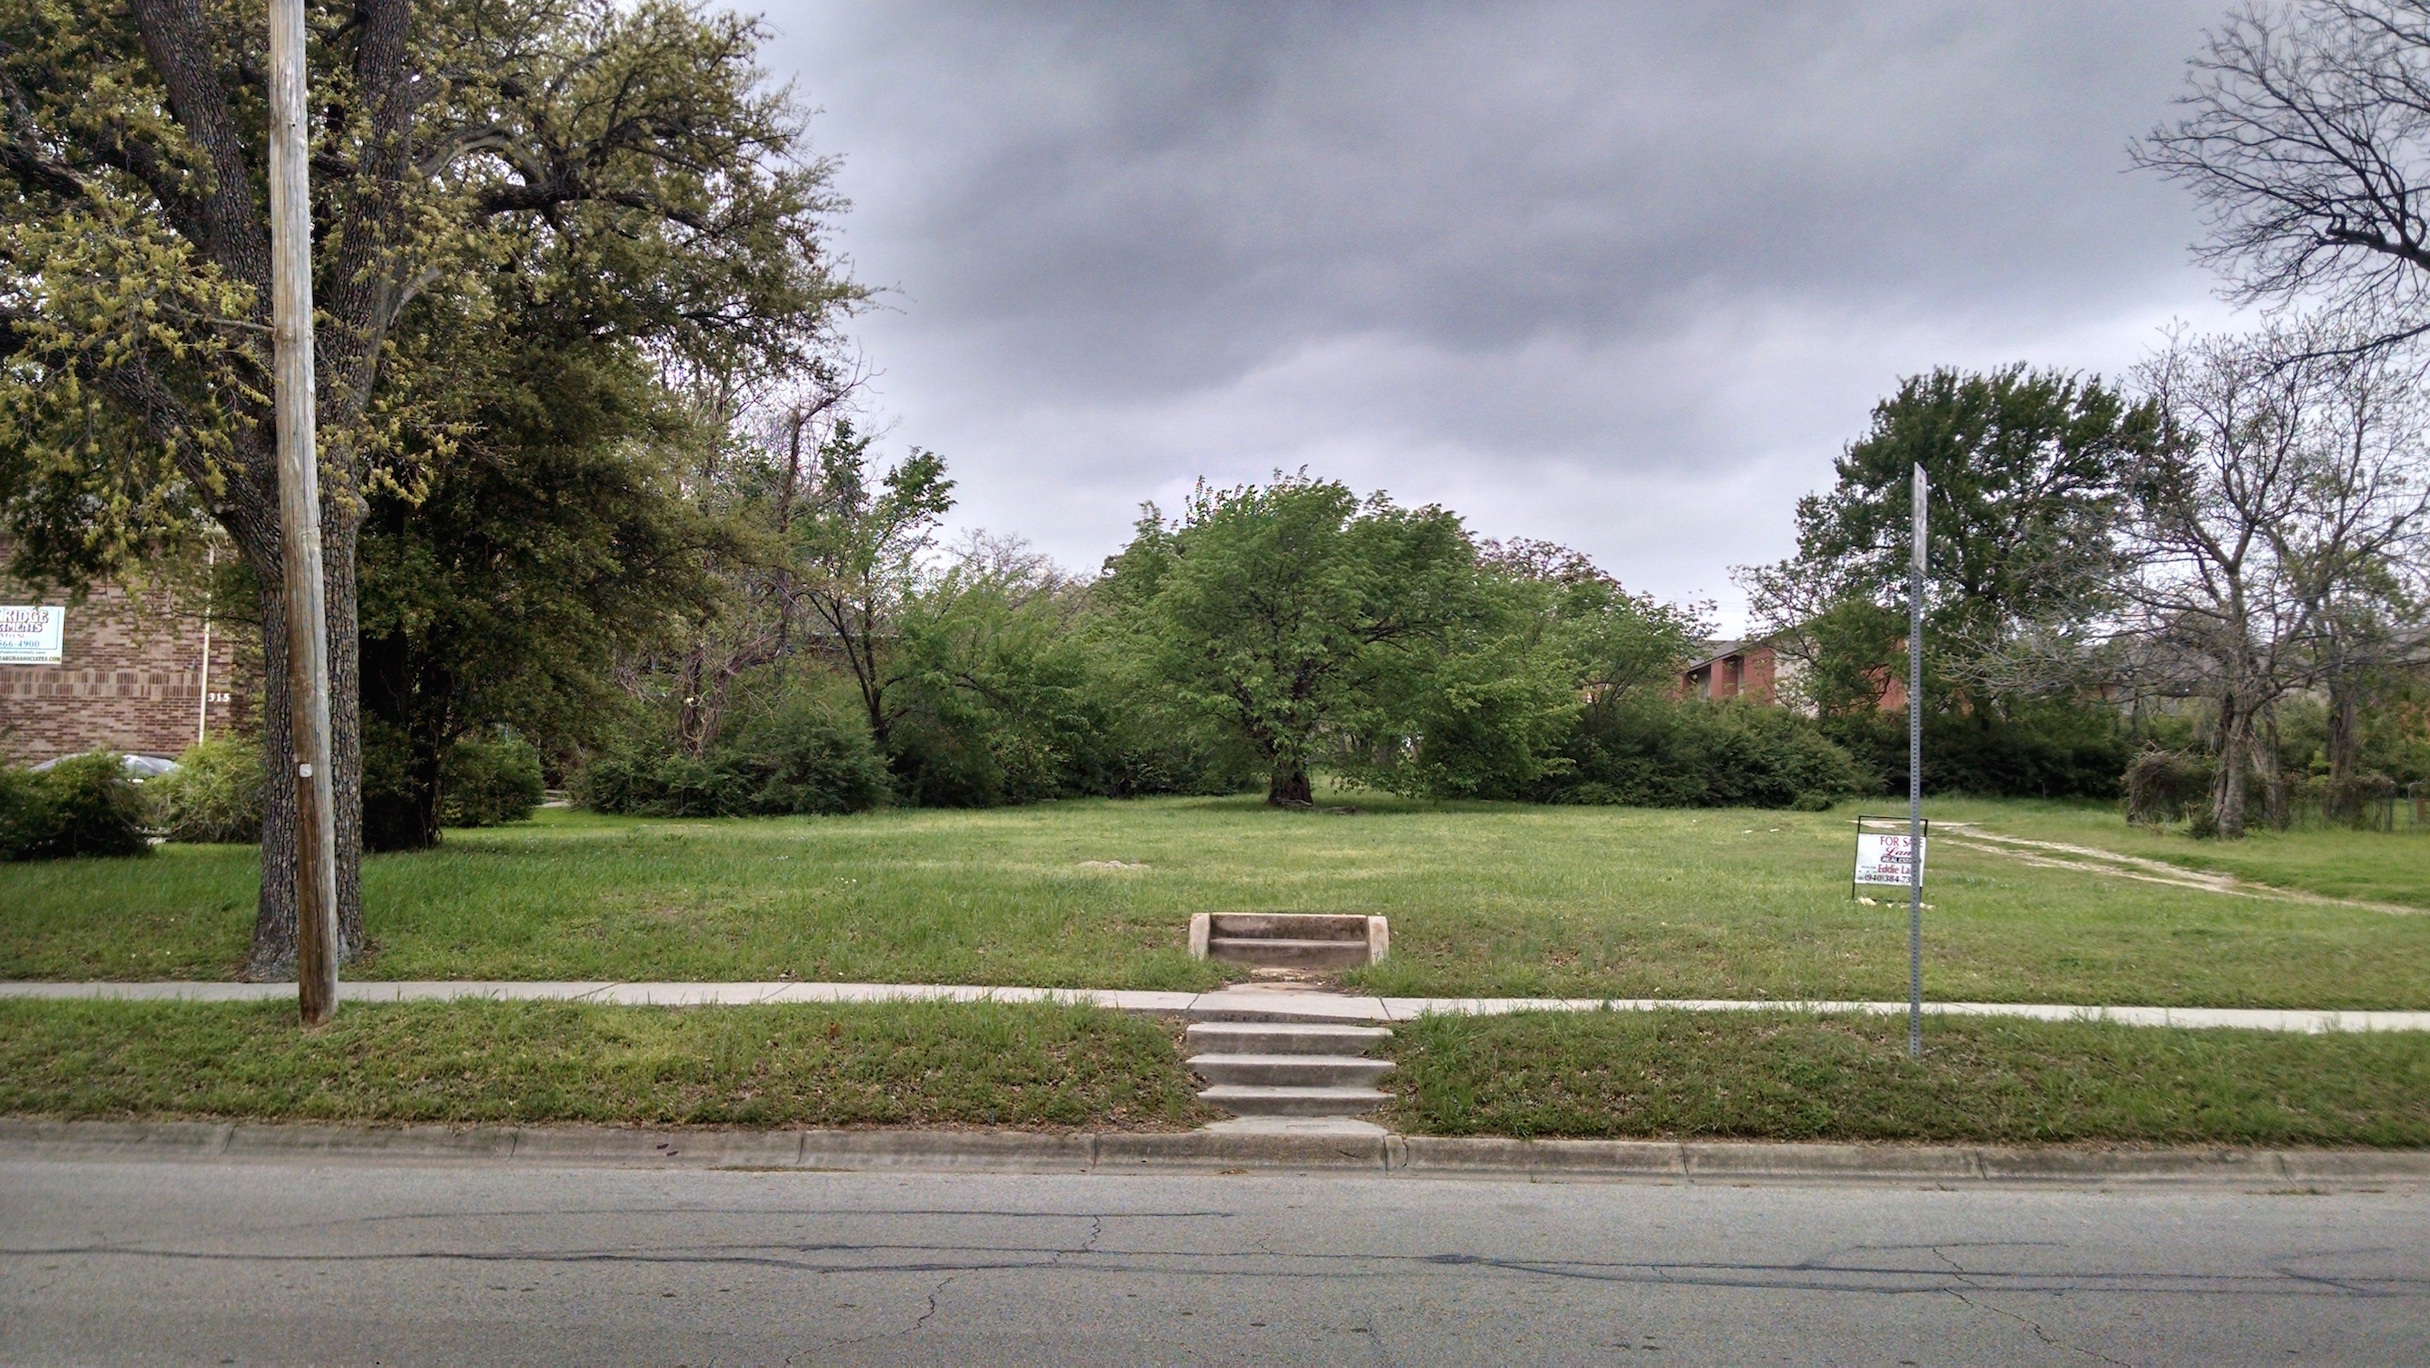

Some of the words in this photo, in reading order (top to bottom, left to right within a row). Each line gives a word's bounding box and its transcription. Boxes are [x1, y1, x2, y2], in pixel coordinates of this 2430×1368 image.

[0, 610, 49, 623] RIDGE
[208, 692, 230, 702] 315
[1880, 836, 1899, 846] FOR
[1878, 864, 1899, 874] Eddie
